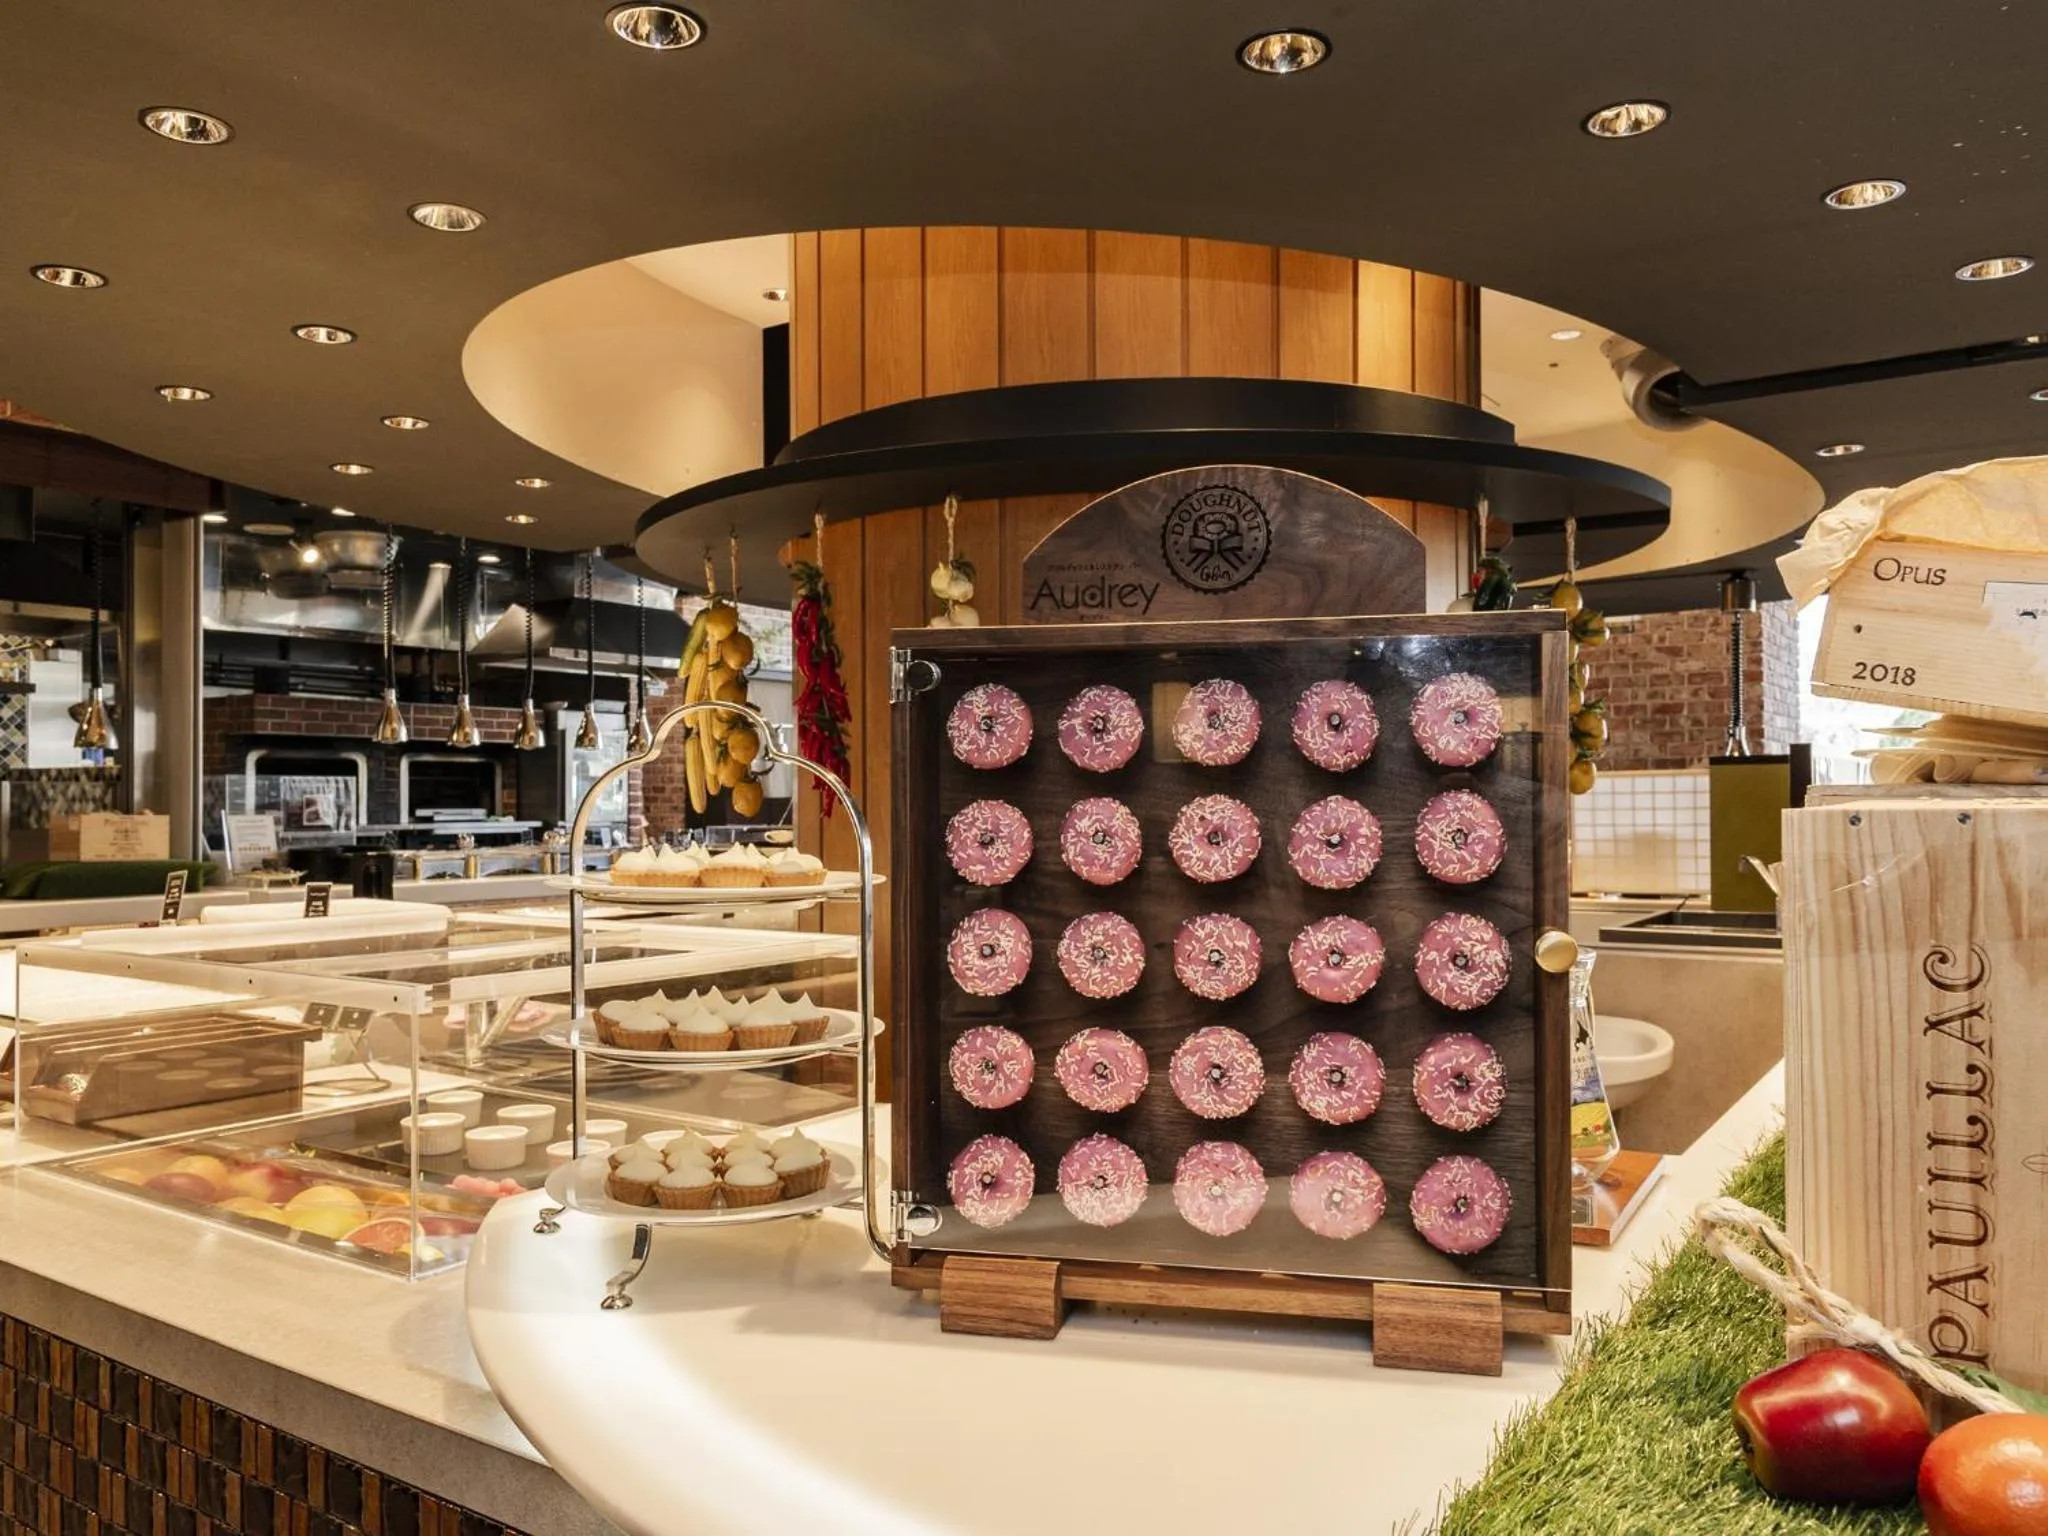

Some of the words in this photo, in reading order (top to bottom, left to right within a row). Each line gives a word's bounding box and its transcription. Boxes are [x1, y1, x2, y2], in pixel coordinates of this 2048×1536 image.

[1172, 493, 1261, 536] DOUGHNUT
[1030, 575, 1160, 615] Audrey
[1852, 661, 1916, 687] 2018
[1922, 943, 1994, 1370] PAUILLAC
